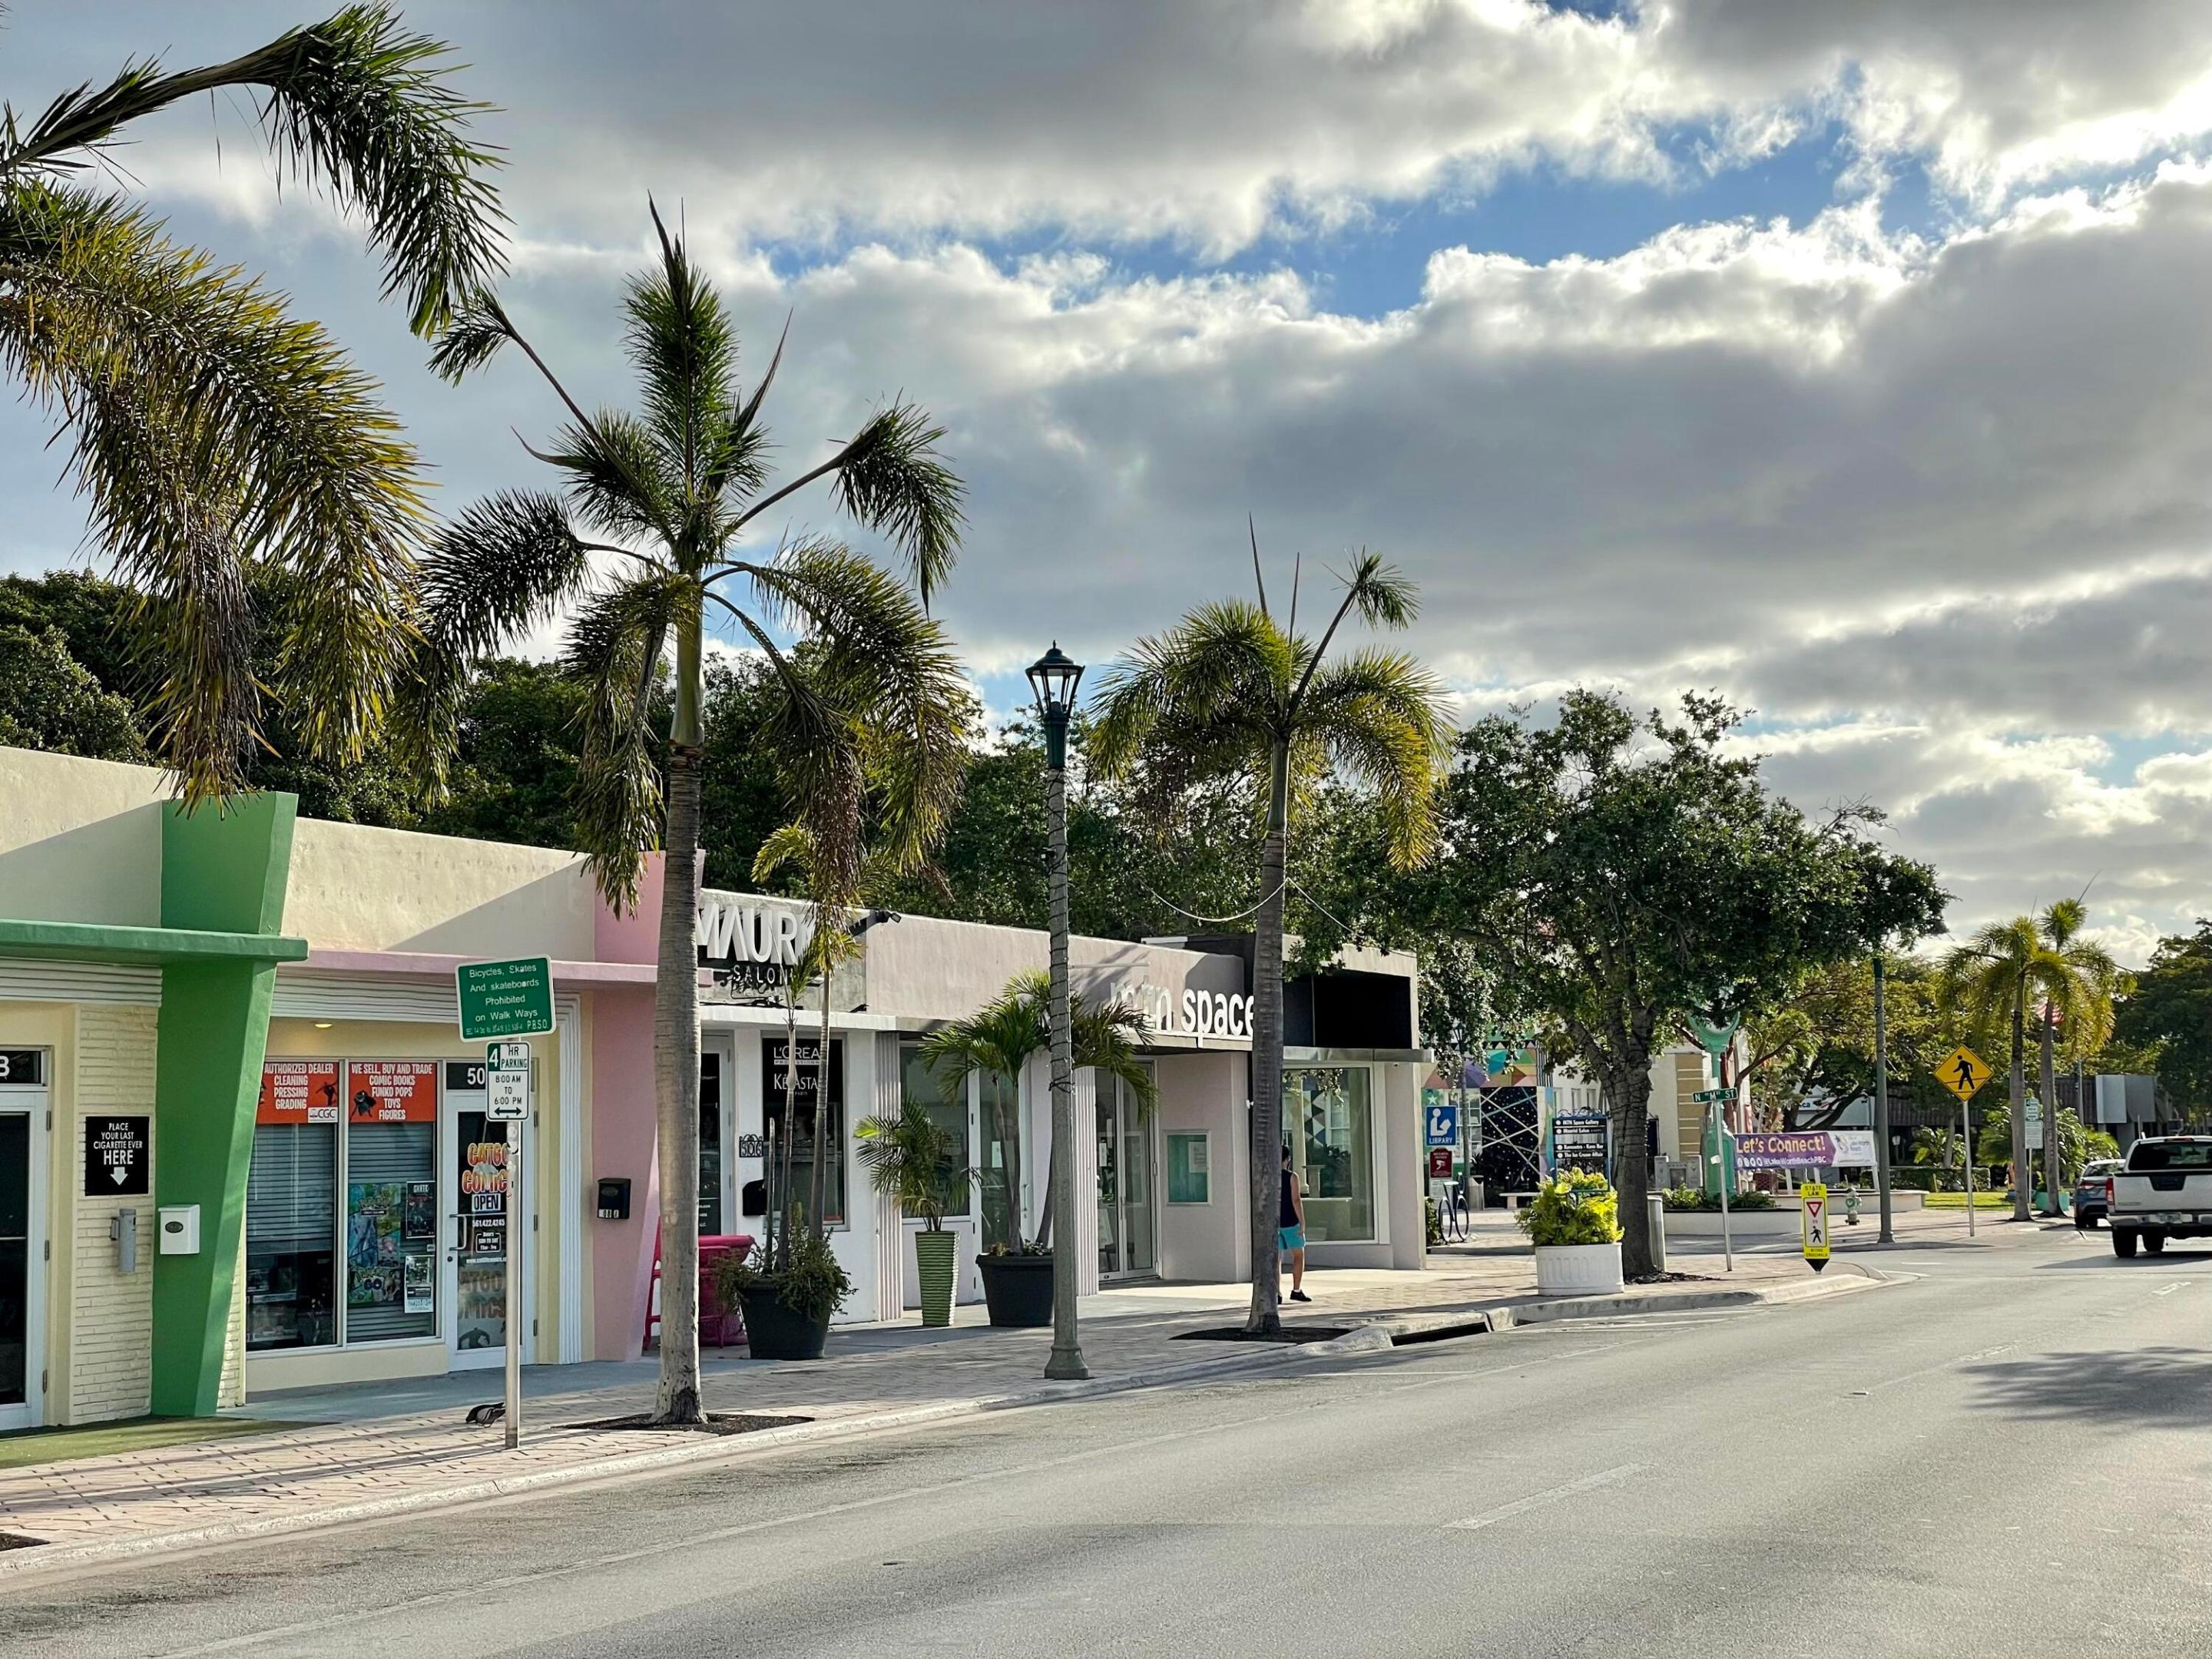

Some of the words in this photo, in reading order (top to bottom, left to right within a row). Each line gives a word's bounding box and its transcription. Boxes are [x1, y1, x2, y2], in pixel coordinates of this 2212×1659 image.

[695, 902, 817, 965] MAUR
[469, 969, 505, 979] Bicycles,
[509, 965, 537, 974] Skates
[470, 984, 486, 992] And
[491, 979, 539, 991] skateboards
[485, 995, 526, 1006] Prohibited
[490, 1012, 511, 1021] Walk
[515, 1009, 538, 1018] Ways
[508, 1046, 519, 1056] HR
[773, 1045, 820, 1059] L'ORÉA
[488, 1048, 499, 1068] 4
[501, 1058, 528, 1068] PARKING
[264, 1063, 306, 1074] AUTHORIZED
[308, 1063, 334, 1074] DEALER
[351, 1064, 363, 1074] WE
[363, 1064, 381, 1075] SELL,
[382, 1064, 396, 1074] BUY
[396, 1064, 411, 1074] AND
[412, 1064, 432, 1074] TRADE
[273, 1075, 308, 1086] CLEANING
[369, 1075, 392, 1086] COMIC
[393, 1075, 416, 1085] BOOKS
[512, 1075, 522, 1083] AM
[773, 1073, 819, 1090] KÉASTA
[273, 1087, 309, 1098] PRESSING
[372, 1087, 394, 1098] FUNKO
[395, 1087, 413, 1098] POPS
[504, 1086, 512, 1094] TO
[1694, 1093, 1701, 1102] N
[1725, 1089, 1734, 1098] ST
[275, 1098, 307, 1110] GRADING
[384, 1098, 401, 1108] TOYS
[318, 1108, 336, 1118] CGC
[379, 1109, 406, 1120] FIGURES
[108, 1122, 129, 1131] PLACE
[101, 1131, 119, 1140] YOUR
[120, 1131, 134, 1140] LAST
[93, 1141, 127, 1149] CIGARETTE
[127, 1141, 143, 1149] EVER
[741, 1142, 762, 1156] 506
[1736, 1137, 1764, 1154] Let's
[1768, 1135, 1826, 1153] Connect!
[103, 1149, 134, 1165] HERE
[462, 1169, 508, 1194] COMIC
[473, 1195, 499, 1210] OPEN
